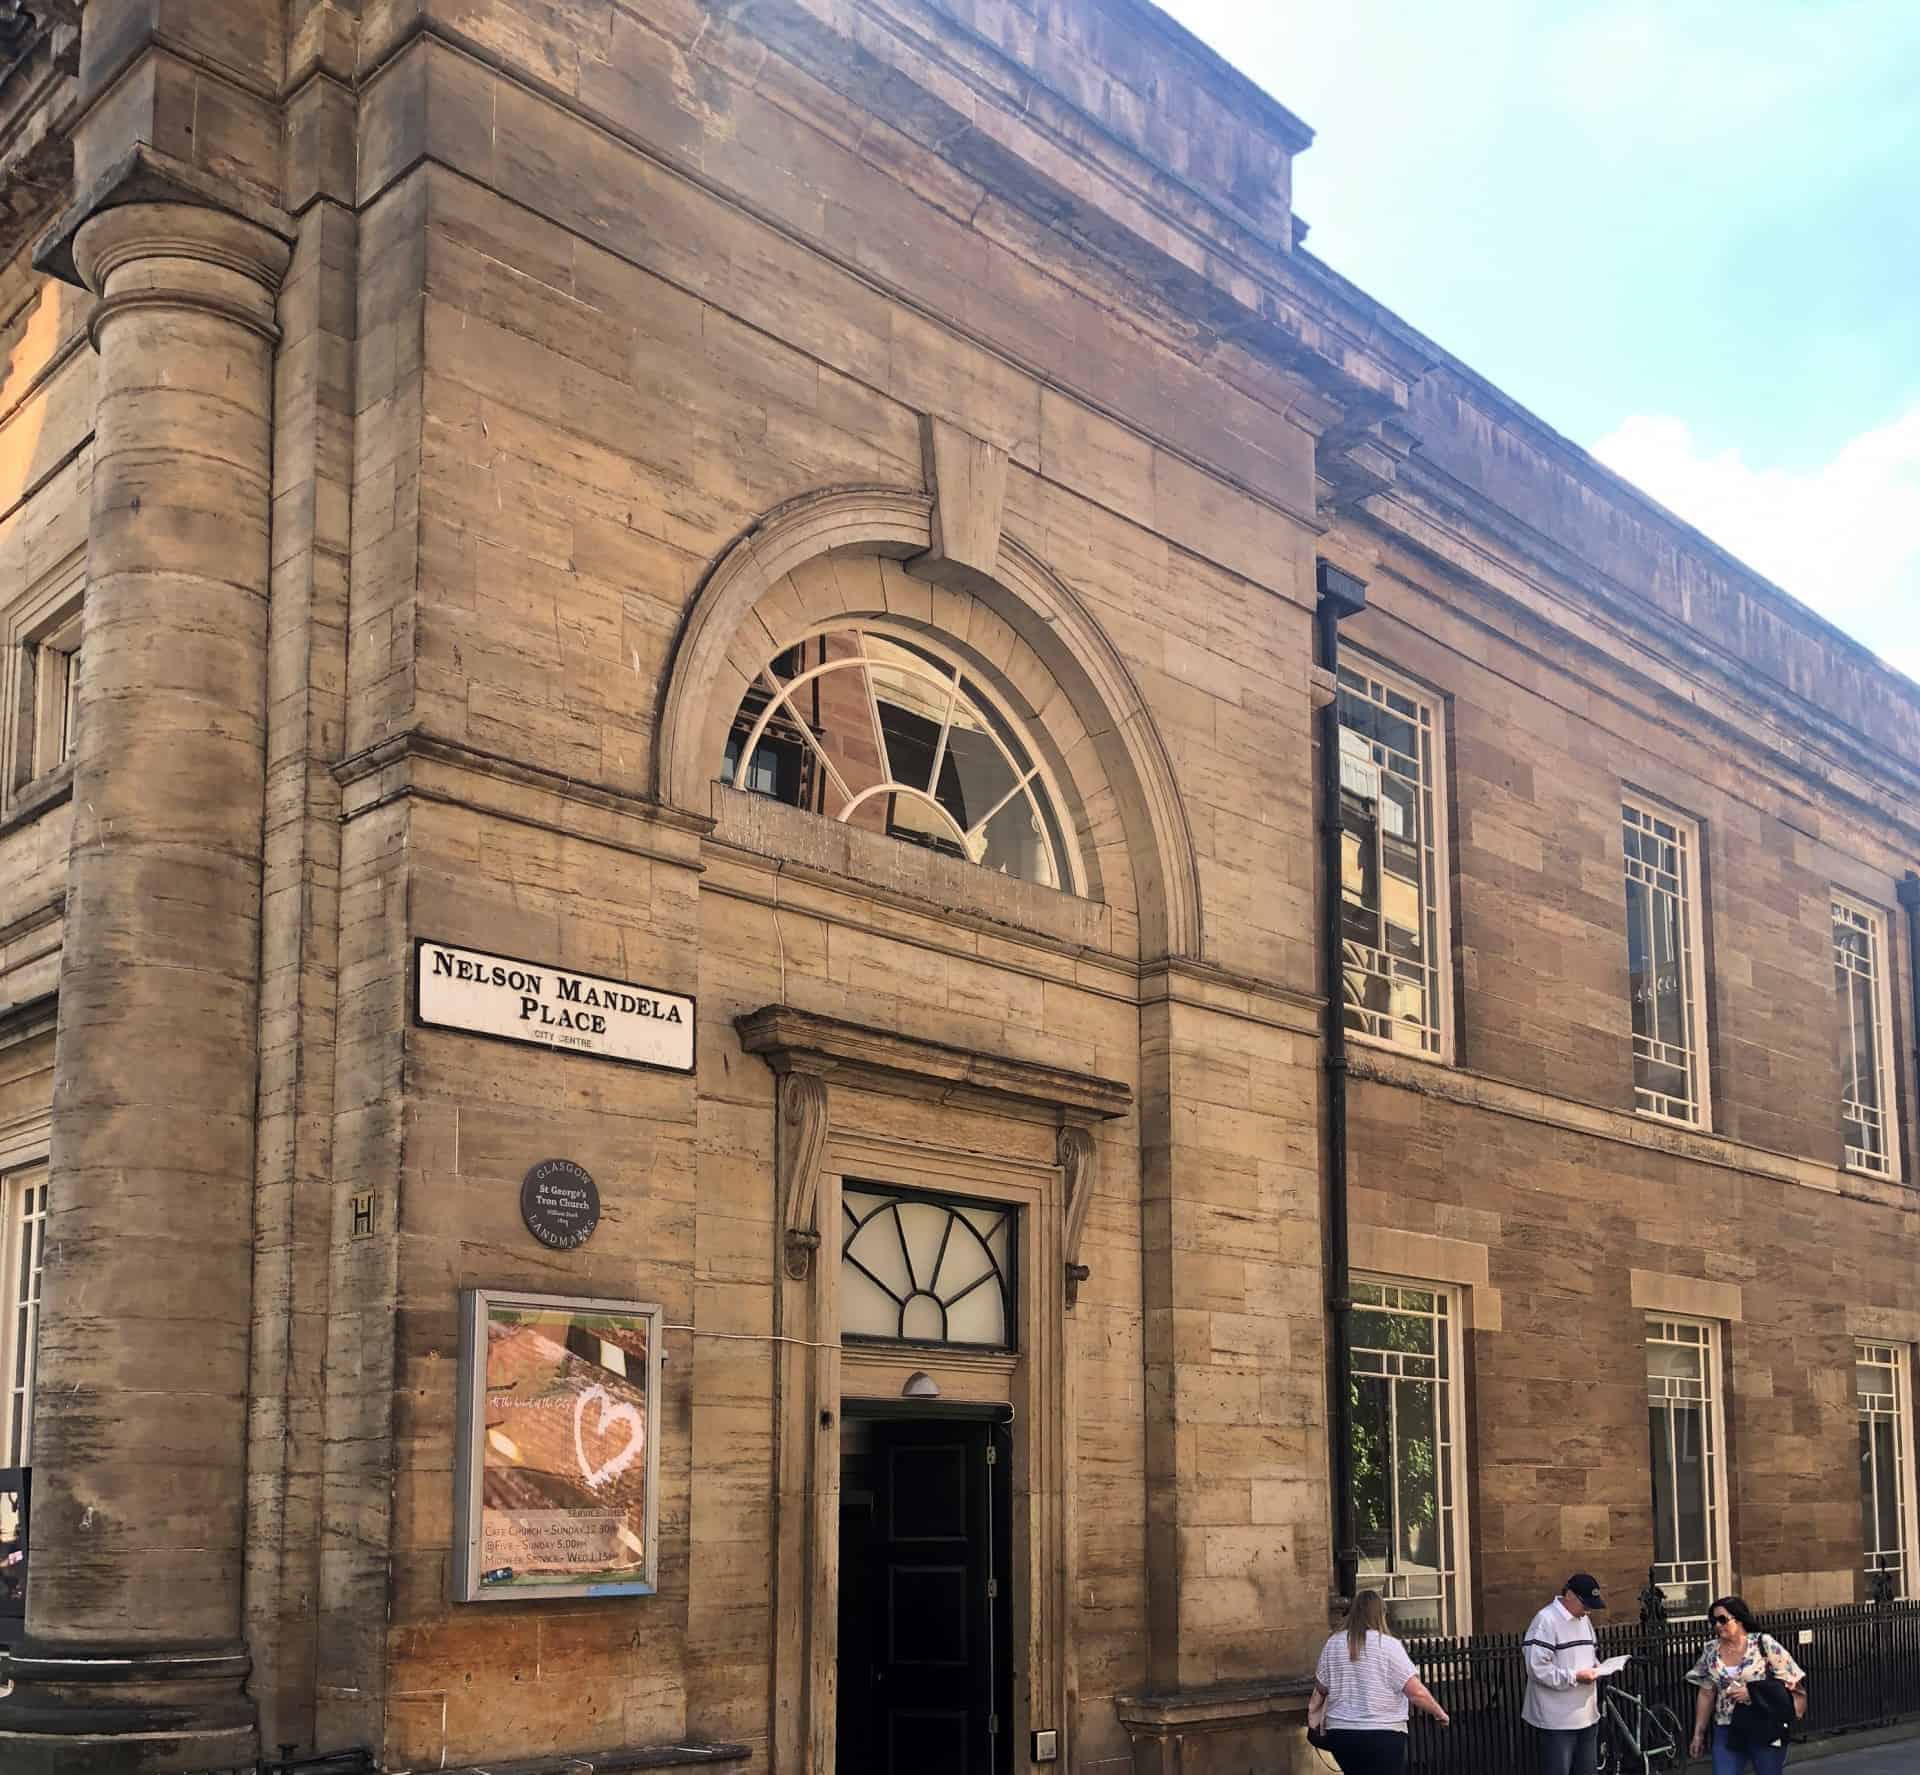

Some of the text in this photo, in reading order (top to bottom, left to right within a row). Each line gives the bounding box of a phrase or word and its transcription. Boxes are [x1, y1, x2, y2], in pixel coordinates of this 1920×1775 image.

[432, 951, 683, 1024] NELSON MANDELA
[519, 996, 607, 1035] PLACE
[535, 1030, 593, 1048] CITY CENTRE
[537, 1162, 590, 1184] GLASGOW
[539, 1184, 549, 1194] St
[536, 1195, 590, 1210] Tron Church
